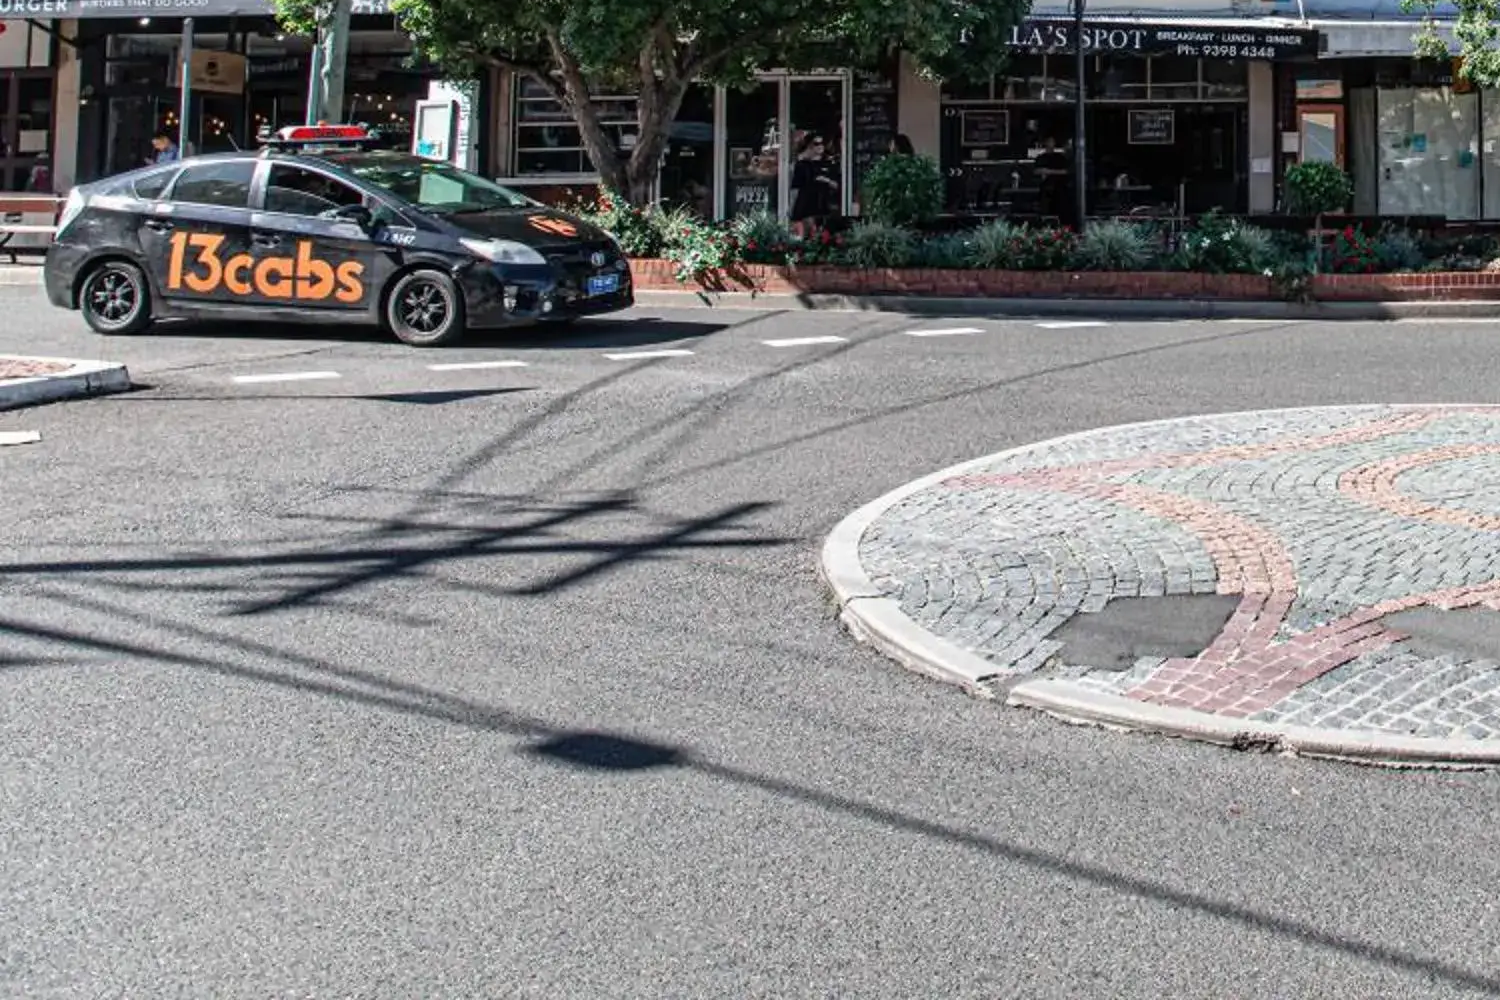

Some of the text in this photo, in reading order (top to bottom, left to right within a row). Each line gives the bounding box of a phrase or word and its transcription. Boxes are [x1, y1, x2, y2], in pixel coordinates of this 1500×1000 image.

[1080, 28, 1147, 49] SPOT
[1157, 31, 1302, 45] BREAKFAST LUNCH DINNER
[1203, 45, 1237, 57] 9398
[1240, 46, 1275, 57] 4348
[168, 231, 365, 303] 13cabs
